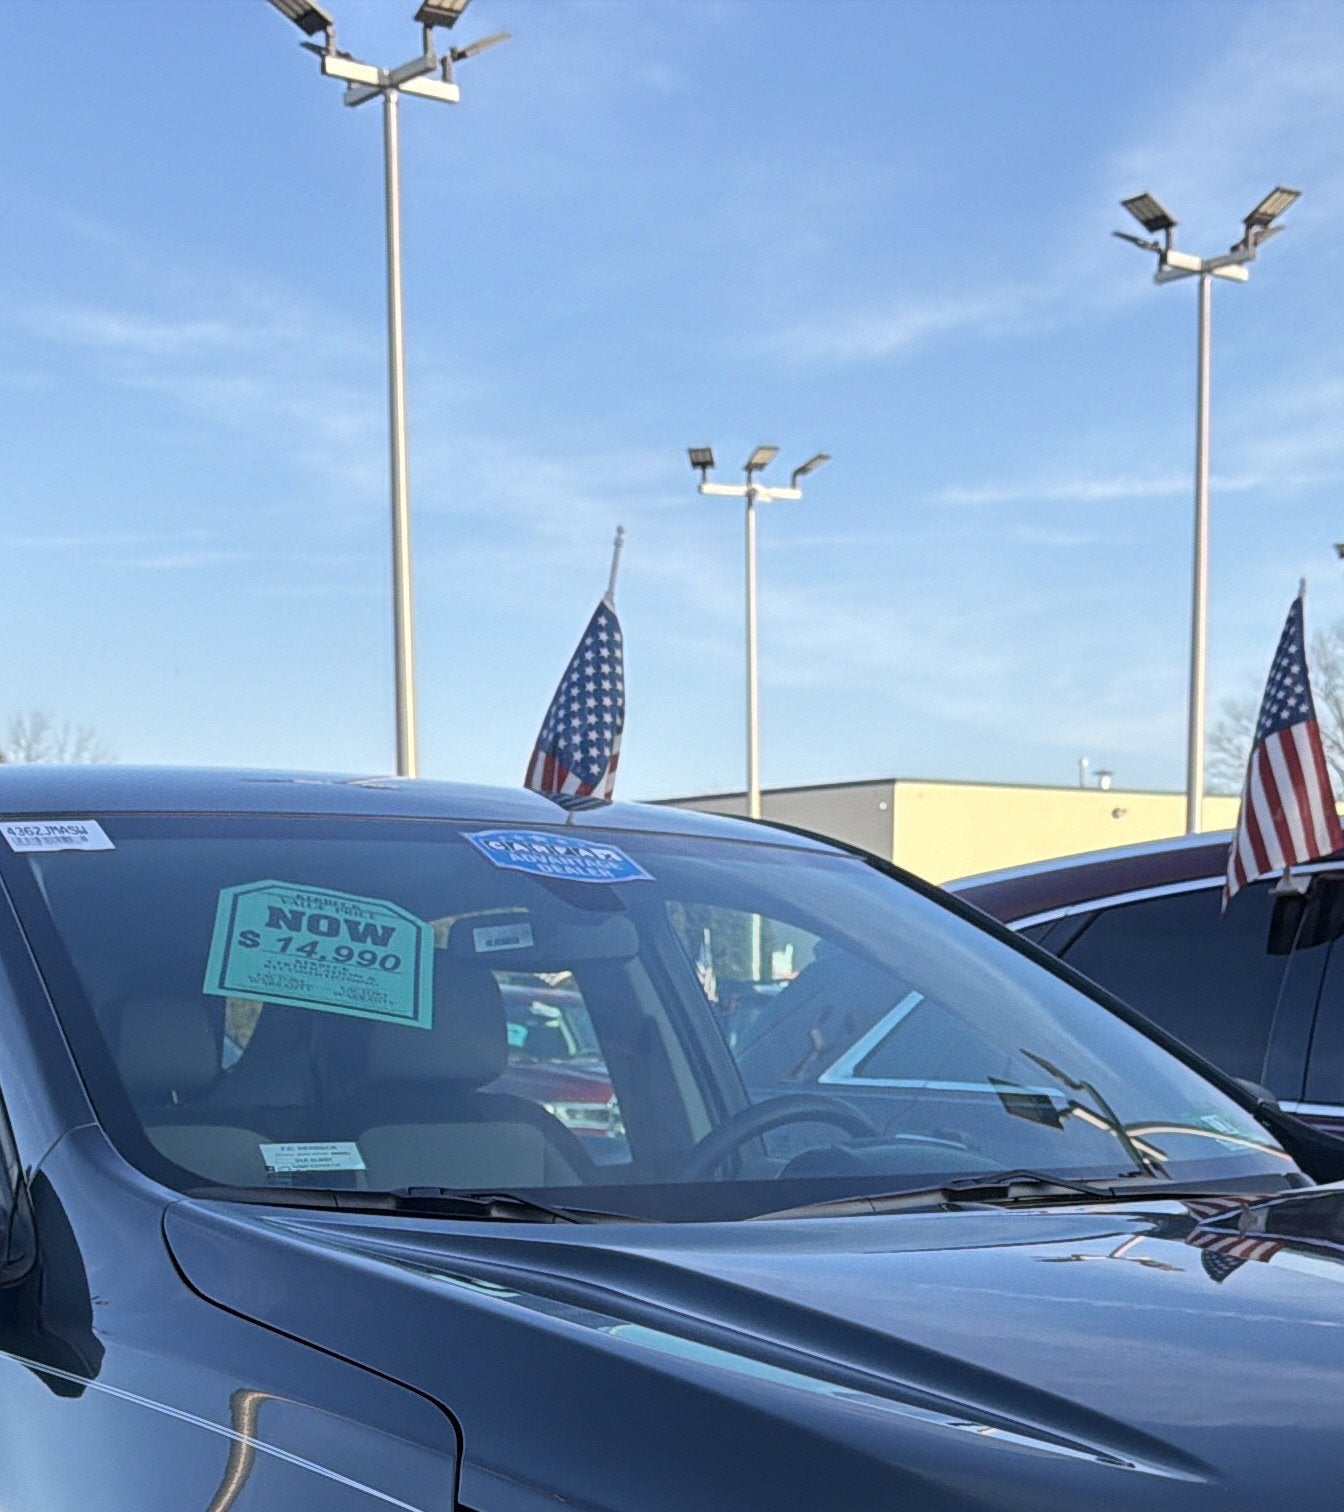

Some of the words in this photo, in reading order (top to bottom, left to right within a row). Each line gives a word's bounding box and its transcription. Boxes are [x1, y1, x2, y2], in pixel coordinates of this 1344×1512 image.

[509, 852, 623, 871] ADVANTAGE
[538, 863, 617, 879] DEALER
[265, 905, 397, 948] NOW
[238, 929, 261, 949] $
[275, 936, 402, 973] 14,990
